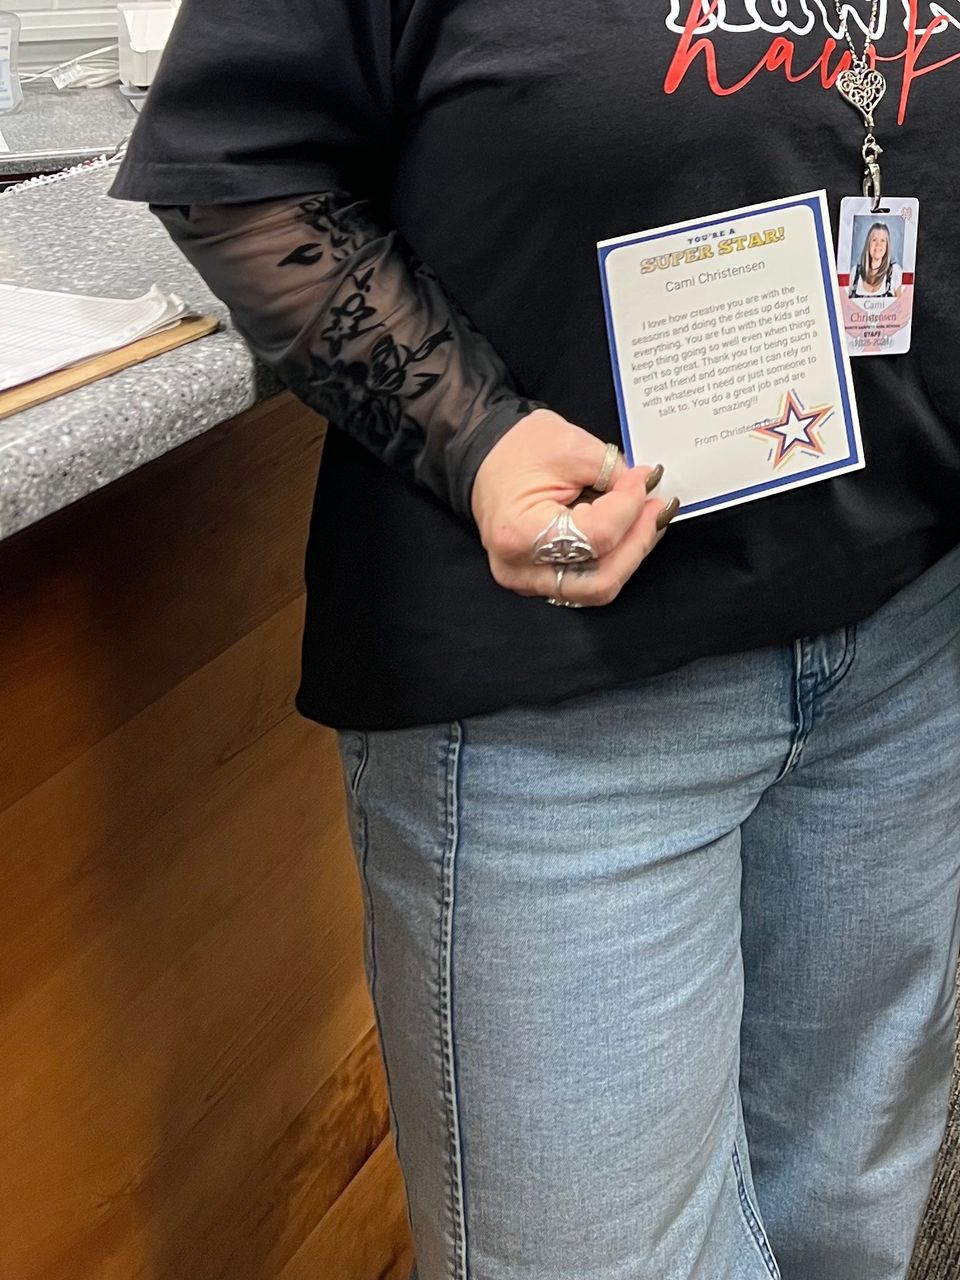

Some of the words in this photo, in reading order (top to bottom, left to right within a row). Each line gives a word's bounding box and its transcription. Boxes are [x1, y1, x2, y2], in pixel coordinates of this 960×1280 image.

[639, 244, 715, 275] SUPER
[718, 226, 786, 256] STAR!
[688, 230, 725, 245] YOU'RE
[665, 276, 696, 293] Cami
[698, 260, 766, 285] Christensen
[632, 330, 670, 345] seasons
[672, 324, 689, 335] and
[691, 318, 717, 331] doing
[718, 314, 733, 324] the
[735, 308, 759, 319] dress
[761, 304, 772, 313] up
[774, 299, 794, 310] days
[796, 295, 808, 304] for
[647, 318, 667, 328] love
[668, 313, 688, 323] how
[689, 303, 725, 318] creative
[727, 299, 743, 311] you
[745, 295, 759, 304] are
[761, 289, 780, 300] with
[781, 286, 795, 295] the
[685, 334, 703, 345] You
[705, 331, 719, 339] are
[721, 326, 736, 336] fun
[738, 320, 757, 331] with
[758, 317, 772, 326] the
[774, 312, 792, 322] kids
[794, 306, 810, 317] and
[850, 312, 897, 323] Christensen
[863, 300, 885, 310] Cami
[632, 360, 654, 371] keep
[656, 354, 679, 365] thing
[681, 346, 706, 361] going
[709, 343, 720, 352] so
[722, 336, 739, 348] well
[742, 332, 762, 343] even
[764, 325, 787, 337] when
[789, 318, 816, 331] things
[660, 369, 672, 377] so
[701, 352, 729, 366] Thank
[732, 349, 748, 360] you
[749, 344, 761, 354] for
[764, 338, 788, 350] being
[790, 331, 810, 343] such
[642, 396, 662, 408] with
[664, 385, 705, 402] whatever
[713, 376, 735, 389] need
[736, 374, 746, 383] or
[748, 369, 764, 382] just
[766, 358, 806, 375] someone
[808, 356, 816, 364] to
[643, 381, 668, 397] great
[670, 374, 696, 388] friend
[699, 368, 715, 380] and
[717, 358, 758, 376] someone
[765, 352, 781, 362] can
[783, 347, 798, 358] rely
[800, 344, 812, 353] on
[658, 405, 677, 416] talk
[692, 397, 709, 407] You
[711, 393, 723, 402] do
[733, 384, 755, 398] great
[758, 380, 771, 392] job
[773, 374, 790, 386] and
[791, 372, 805, 380] are
[694, 433, 718, 447] From
